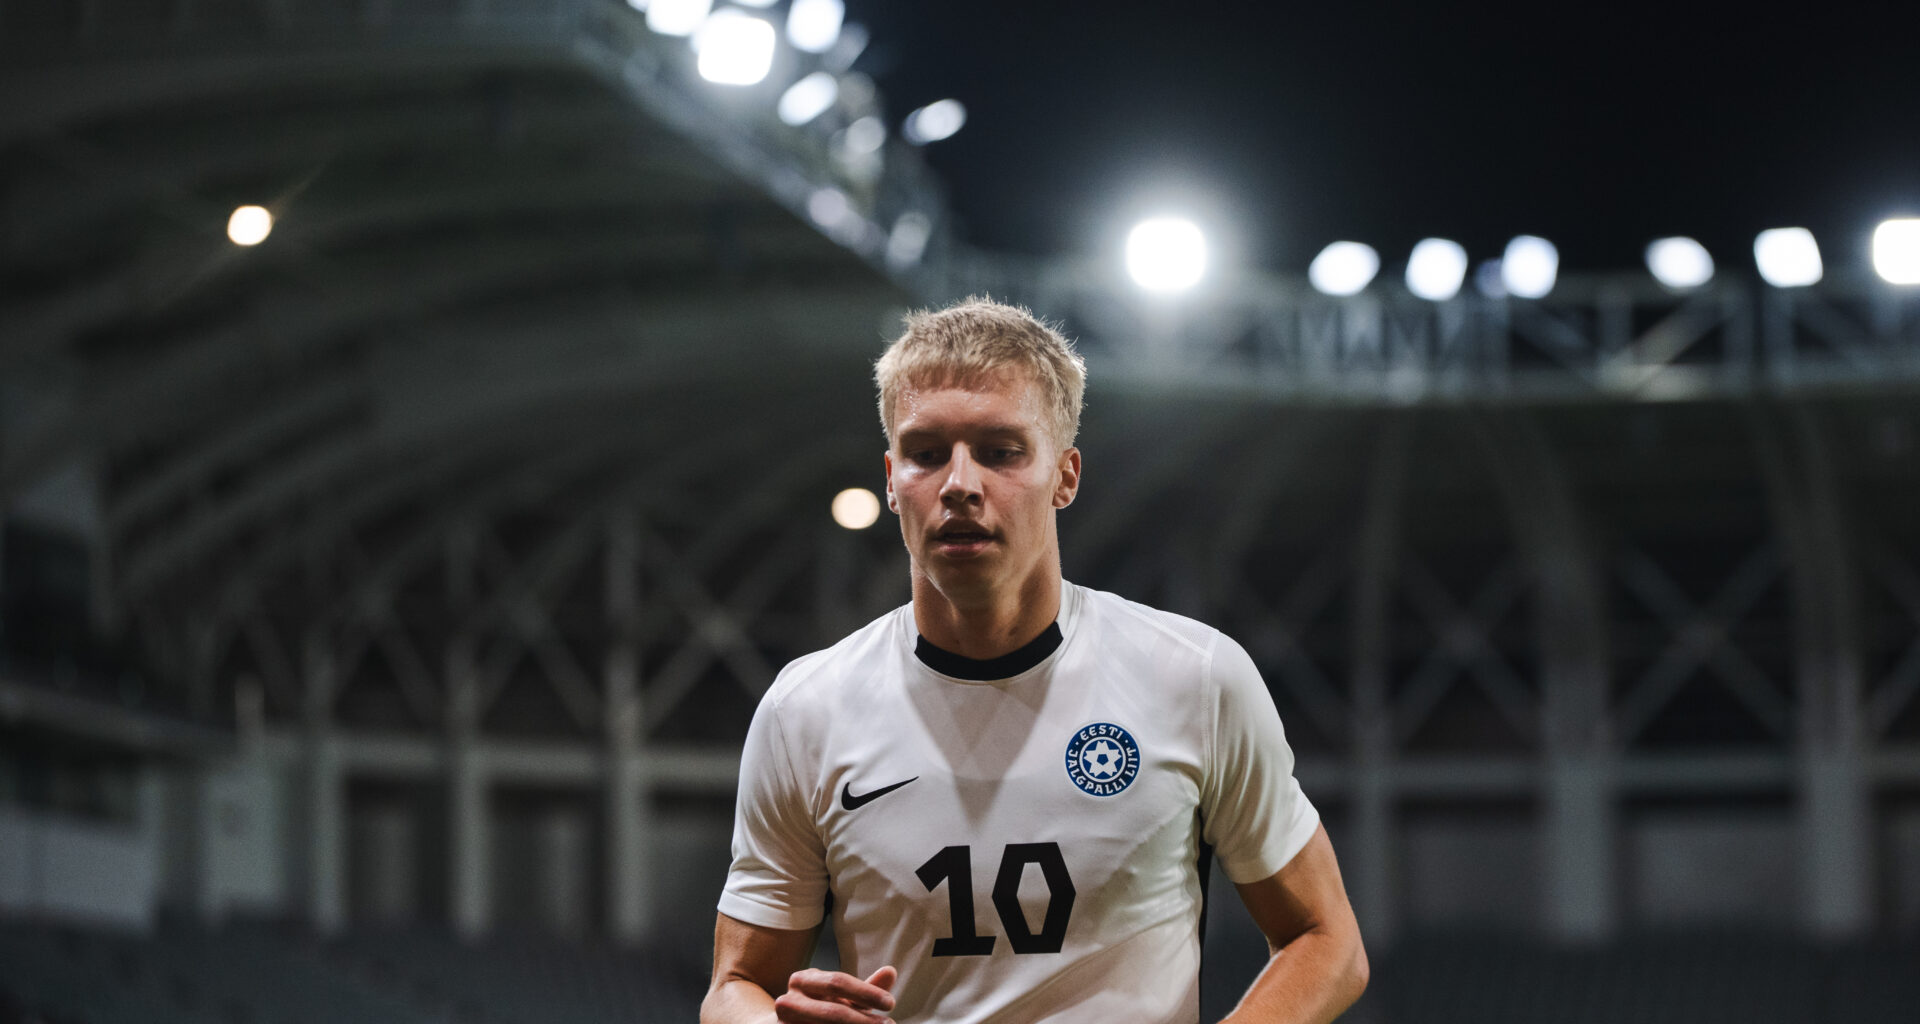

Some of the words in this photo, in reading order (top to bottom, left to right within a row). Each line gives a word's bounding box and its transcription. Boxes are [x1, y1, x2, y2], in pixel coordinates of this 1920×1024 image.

[1080, 725, 1124, 741] EESTI
[1068, 749, 1126, 794] JALGPALLI
[1125, 747, 1138, 777] LIIT
[915, 841, 1077, 957] 10
